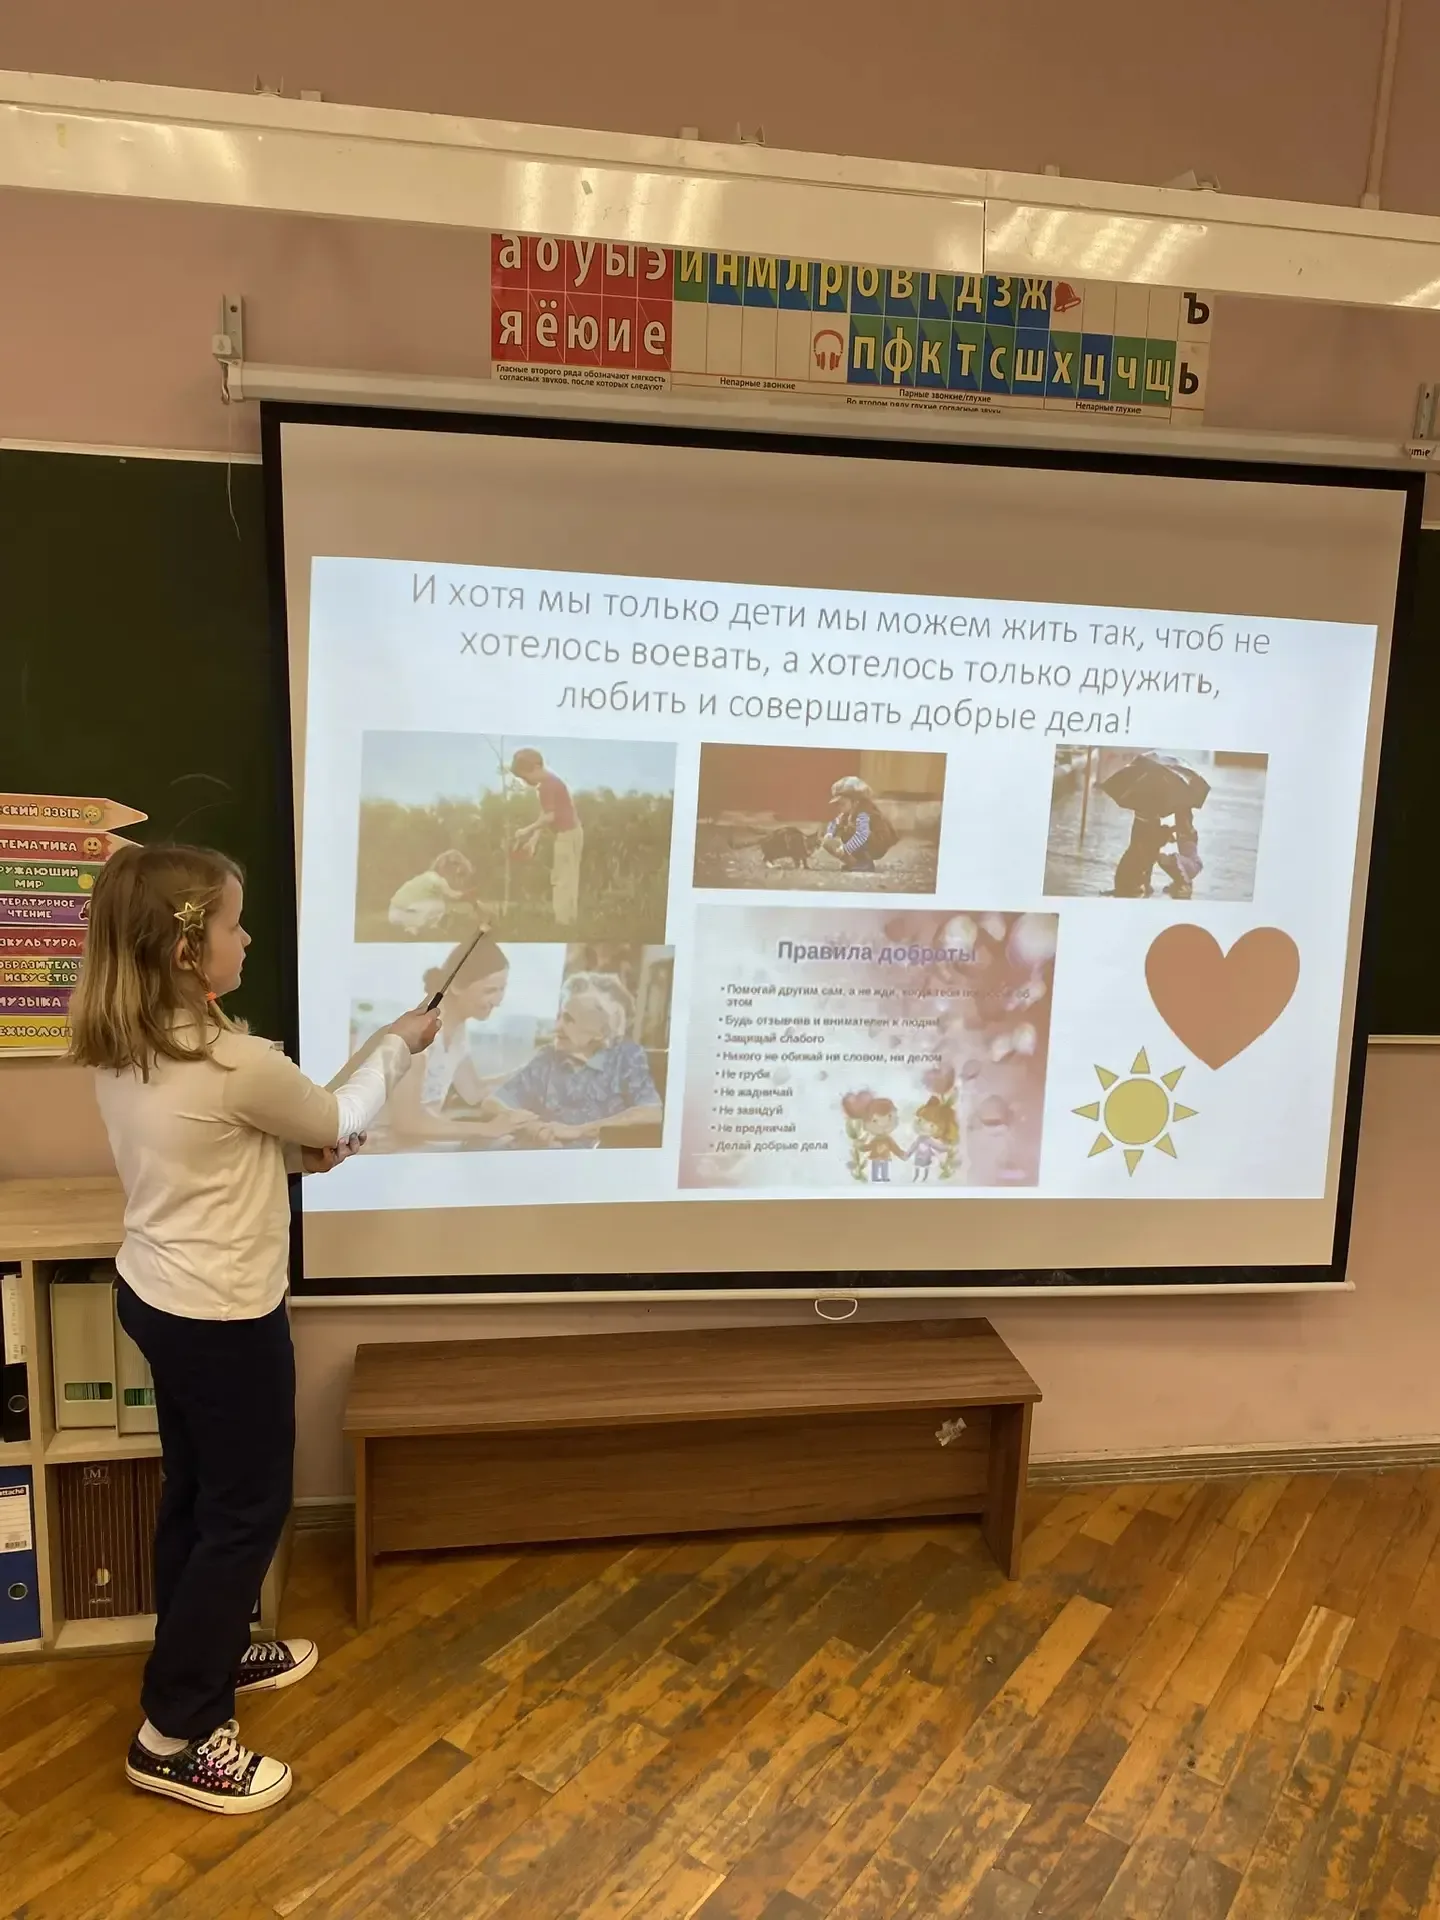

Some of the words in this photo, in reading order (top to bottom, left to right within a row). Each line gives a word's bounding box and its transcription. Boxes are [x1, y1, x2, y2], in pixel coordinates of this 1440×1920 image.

[498, 310, 523, 345] я
[535, 299, 560, 348] ё
[567, 314, 600, 350] ю
[608, 317, 632, 353] и
[643, 320, 667, 356] е
[852, 336, 876, 370] п
[883, 326, 914, 384] ф
[920, 340, 943, 374] к
[957, 343, 977, 377] т
[989, 347, 1007, 380] с
[1014, 349, 1045, 382] ш
[1051, 351, 1073, 384] х
[1083, 353, 1106, 395] ц
[1117, 356, 1137, 389] ч
[1145, 359, 1172, 401] щ
[496, 364, 529, 374] Гласные
[531, 367, 562, 377] второго
[563, 370, 583, 379] ряда
[583, 370, 630, 381] обозначают
[631, 375, 666, 383] мягкость
[499, 374, 540, 382] согласных
[571, 379, 595, 387] после
[596, 381, 629, 389] которых
[630, 382, 664, 391] следуют
[719, 377, 761, 389] Непарные
[762, 381, 797, 391] звонкие
[899, 388, 930, 399] Парные
[931, 391, 992, 404] звонкие/глухие
[1075, 401, 1115, 413] Непарные
[1115, 406, 1142, 415] глухие
[412, 572, 437, 605] И
[448, 582, 525, 611] хотя
[538, 588, 590, 615] мы
[603, 592, 720, 624] только
[728, 601, 806, 631] дети
[817, 606, 867, 632] мы
[877, 610, 991, 639] можем
[1001, 617, 1078, 644] жить
[1089, 621, 1145, 652] так,
[1155, 622, 1225, 652] чтоб
[1235, 630, 1271, 656] не
[459, 631, 620, 664] хотелось
[632, 641, 770, 677] воевать,
[782, 650, 799, 674] а
[809, 651, 954, 682] хотелось
[964, 660, 1072, 688] только
[1079, 667, 1221, 699] дружить,
[556, 680, 687, 715] любить
[699, 692, 717, 717] и
[729, 694, 902, 727] совершать
[910, 698, 1037, 735] добрые
[1044, 705, 1133, 738] дела!
[0, 803, 39, 817] СКИЙ
[43, 807, 81, 818] ЯЗЫК
[15, 879, 44, 889] МИР
[7, 909, 53, 919] ЧТЕНИЕ
[777, 940, 873, 964] Правила
[878, 943, 977, 966] доброты
[4, 973, 78, 983] ИСКУССТВО
[726, 983, 777, 996] Помогай
[778, 984, 819, 998] другим
[858, 987, 872, 996] не
[726, 998, 754, 1008] этом
[725, 1014, 754, 1028] Будь
[823, 1016, 890, 1027] внимателен
[723, 1032, 777, 1045] Защищай
[779, 1033, 825, 1044] слабого
[722, 1051, 762, 1062] Никого
[764, 1053, 779, 1062] не
[780, 1051, 823, 1062] обижай
[825, 1053, 841, 1062] ни
[889, 1054, 905, 1063] ни
[906, 1054, 942, 1065] делом
[721, 1069, 737, 1080] Не
[720, 1087, 736, 1097] Не
[737, 1086, 794, 1100] жадничай
[719, 1105, 735, 1115] Не
[736, 1104, 784, 1117] завидуй
[717, 1123, 733, 1133] Не
[715, 1140, 752, 1152] Делай
[753, 1141, 799, 1153] добрые
[800, 1141, 829, 1153] дела
